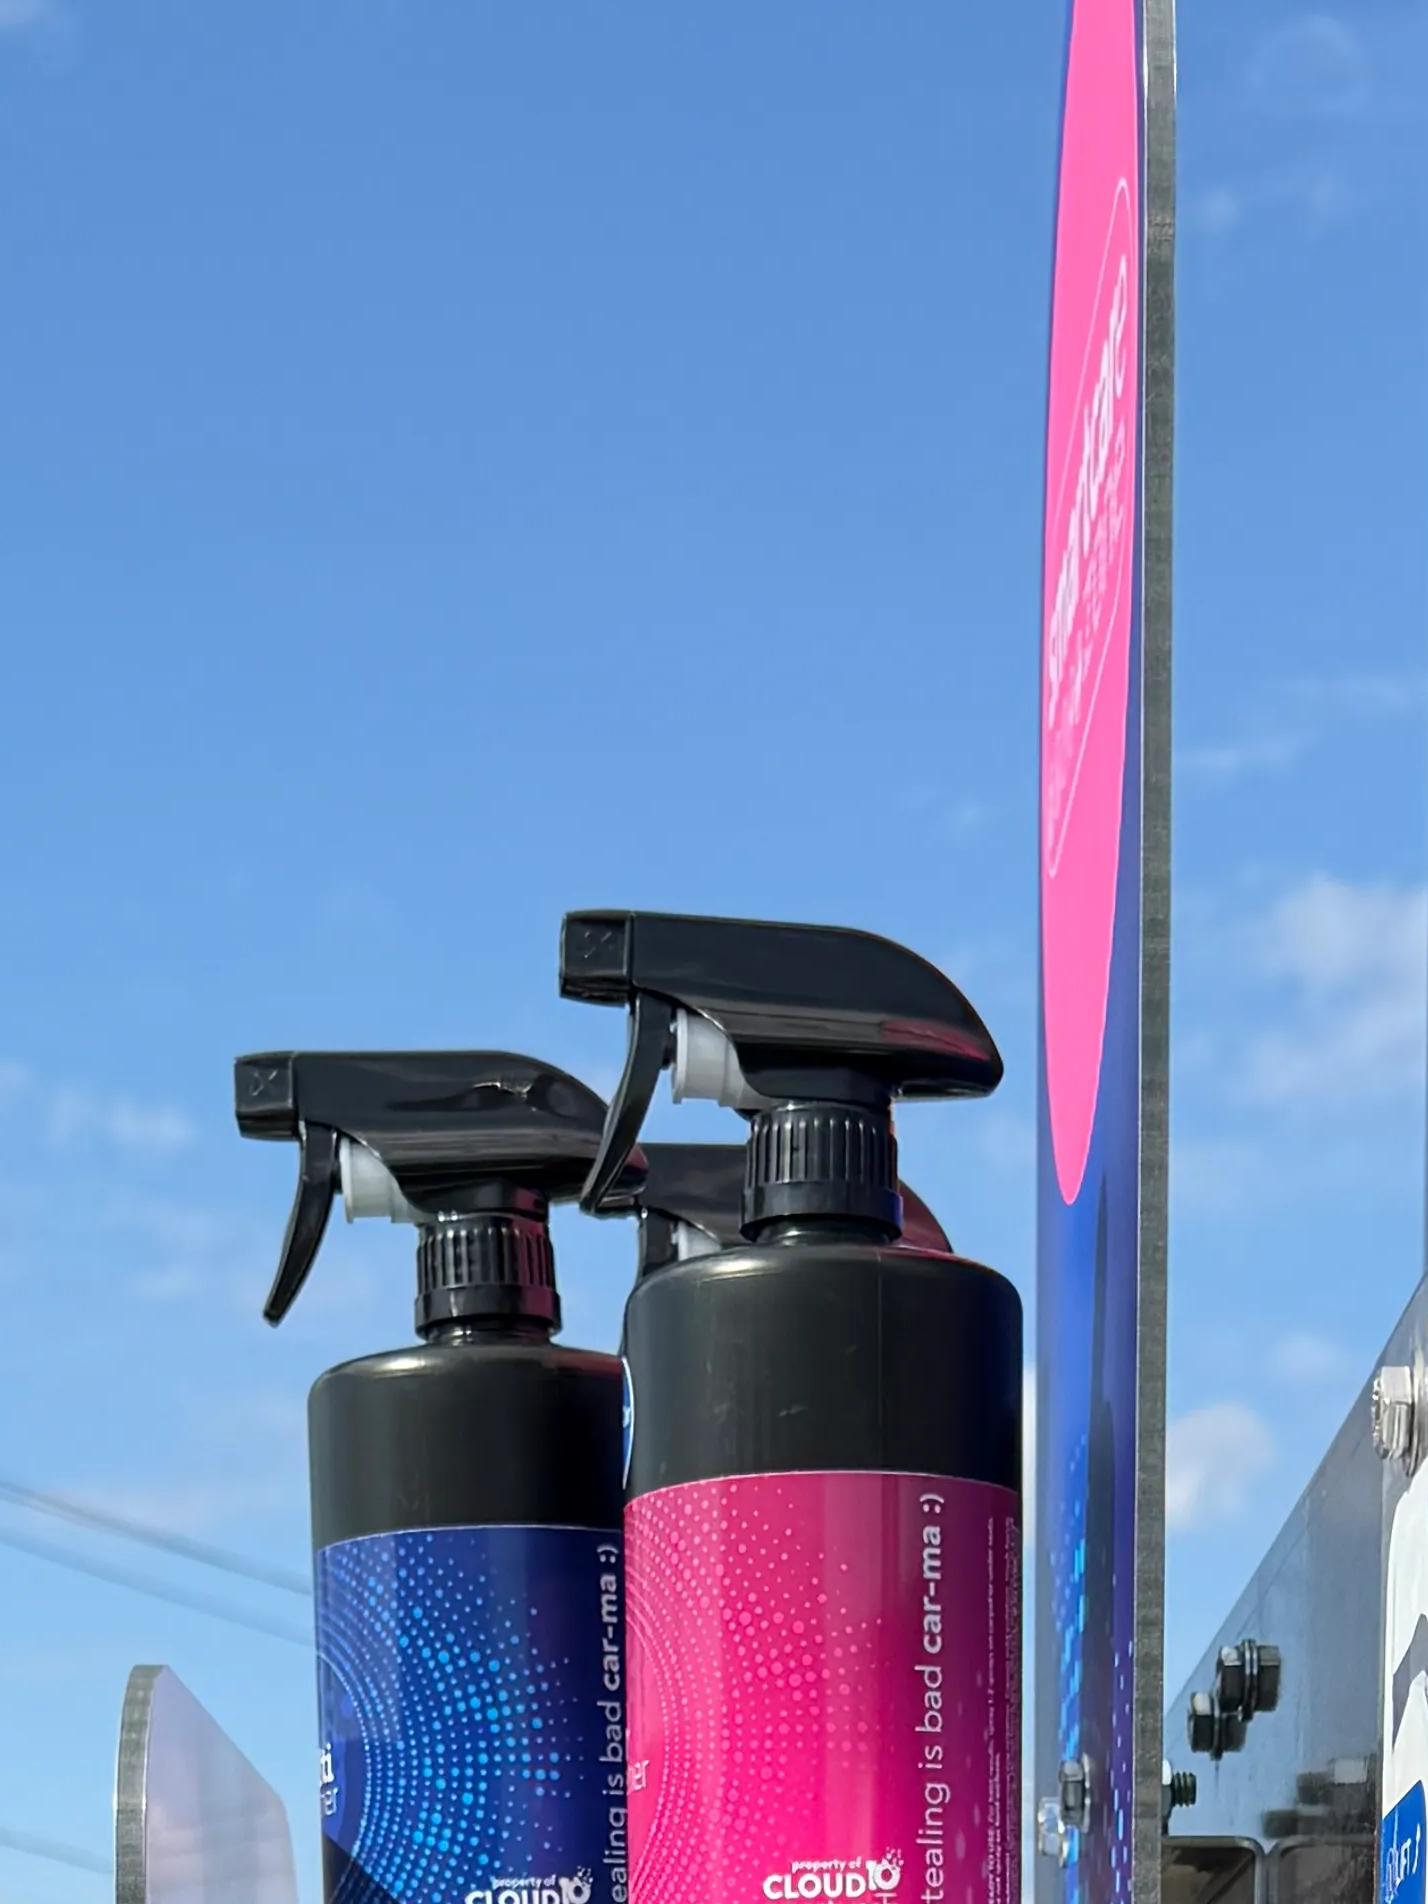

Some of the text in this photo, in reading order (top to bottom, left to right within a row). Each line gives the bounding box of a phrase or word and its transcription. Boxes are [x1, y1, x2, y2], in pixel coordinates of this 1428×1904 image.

[1048, 255, 1127, 729] smartcare
[922, 1525, 943, 1654] car-ma
[600, 1573, 620, 1691] car-ma
[914, 1665, 943, 1733] bad
[596, 1701, 623, 1763] bad
[917, 1745, 943, 1769] is
[602, 1773, 624, 1796] is
[791, 1856, 862, 1874] property of
